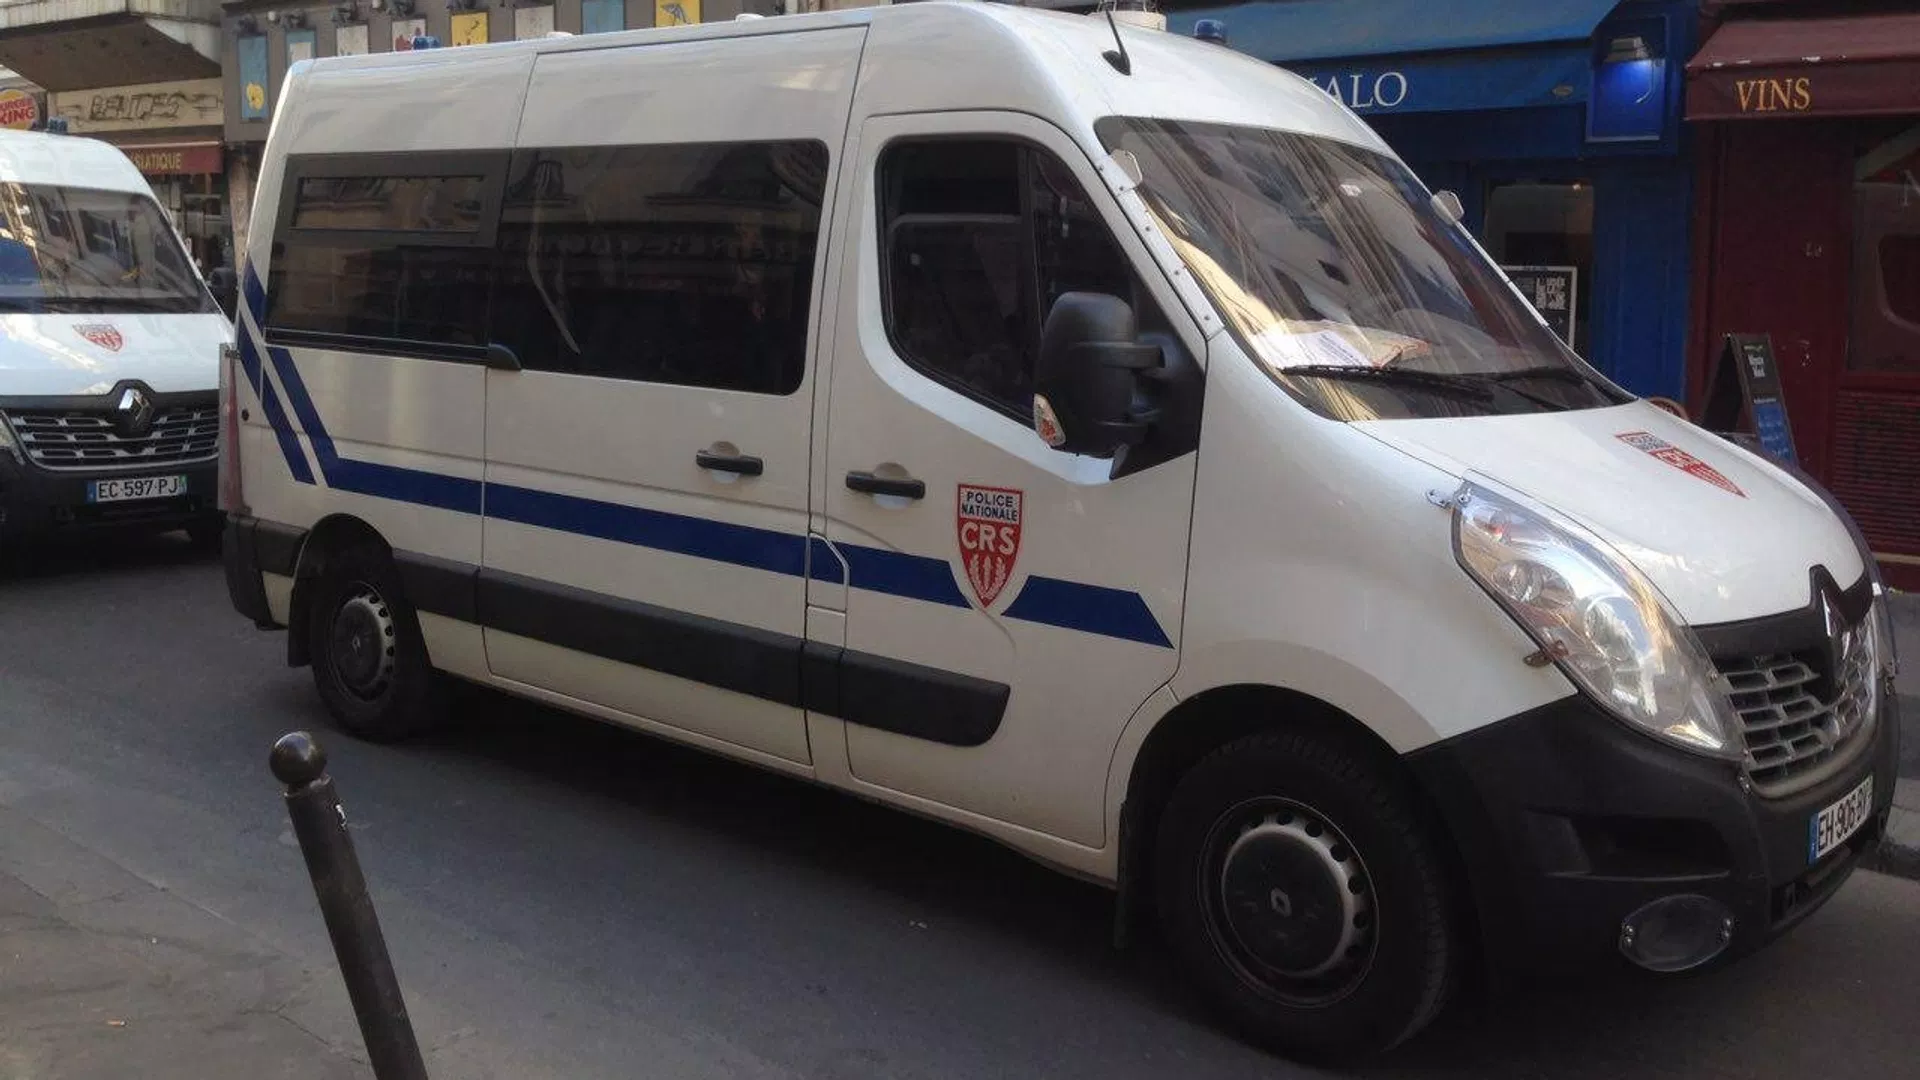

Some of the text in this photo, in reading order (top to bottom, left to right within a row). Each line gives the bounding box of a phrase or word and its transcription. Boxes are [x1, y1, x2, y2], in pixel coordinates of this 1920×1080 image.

[1308, 71, 1408, 108] ALO
[1735, 77, 1810, 112] VINS
[962, 503, 1018, 521] NATIONALE
[966, 491, 1013, 508] POLICE
[961, 521, 1015, 555] CRS
